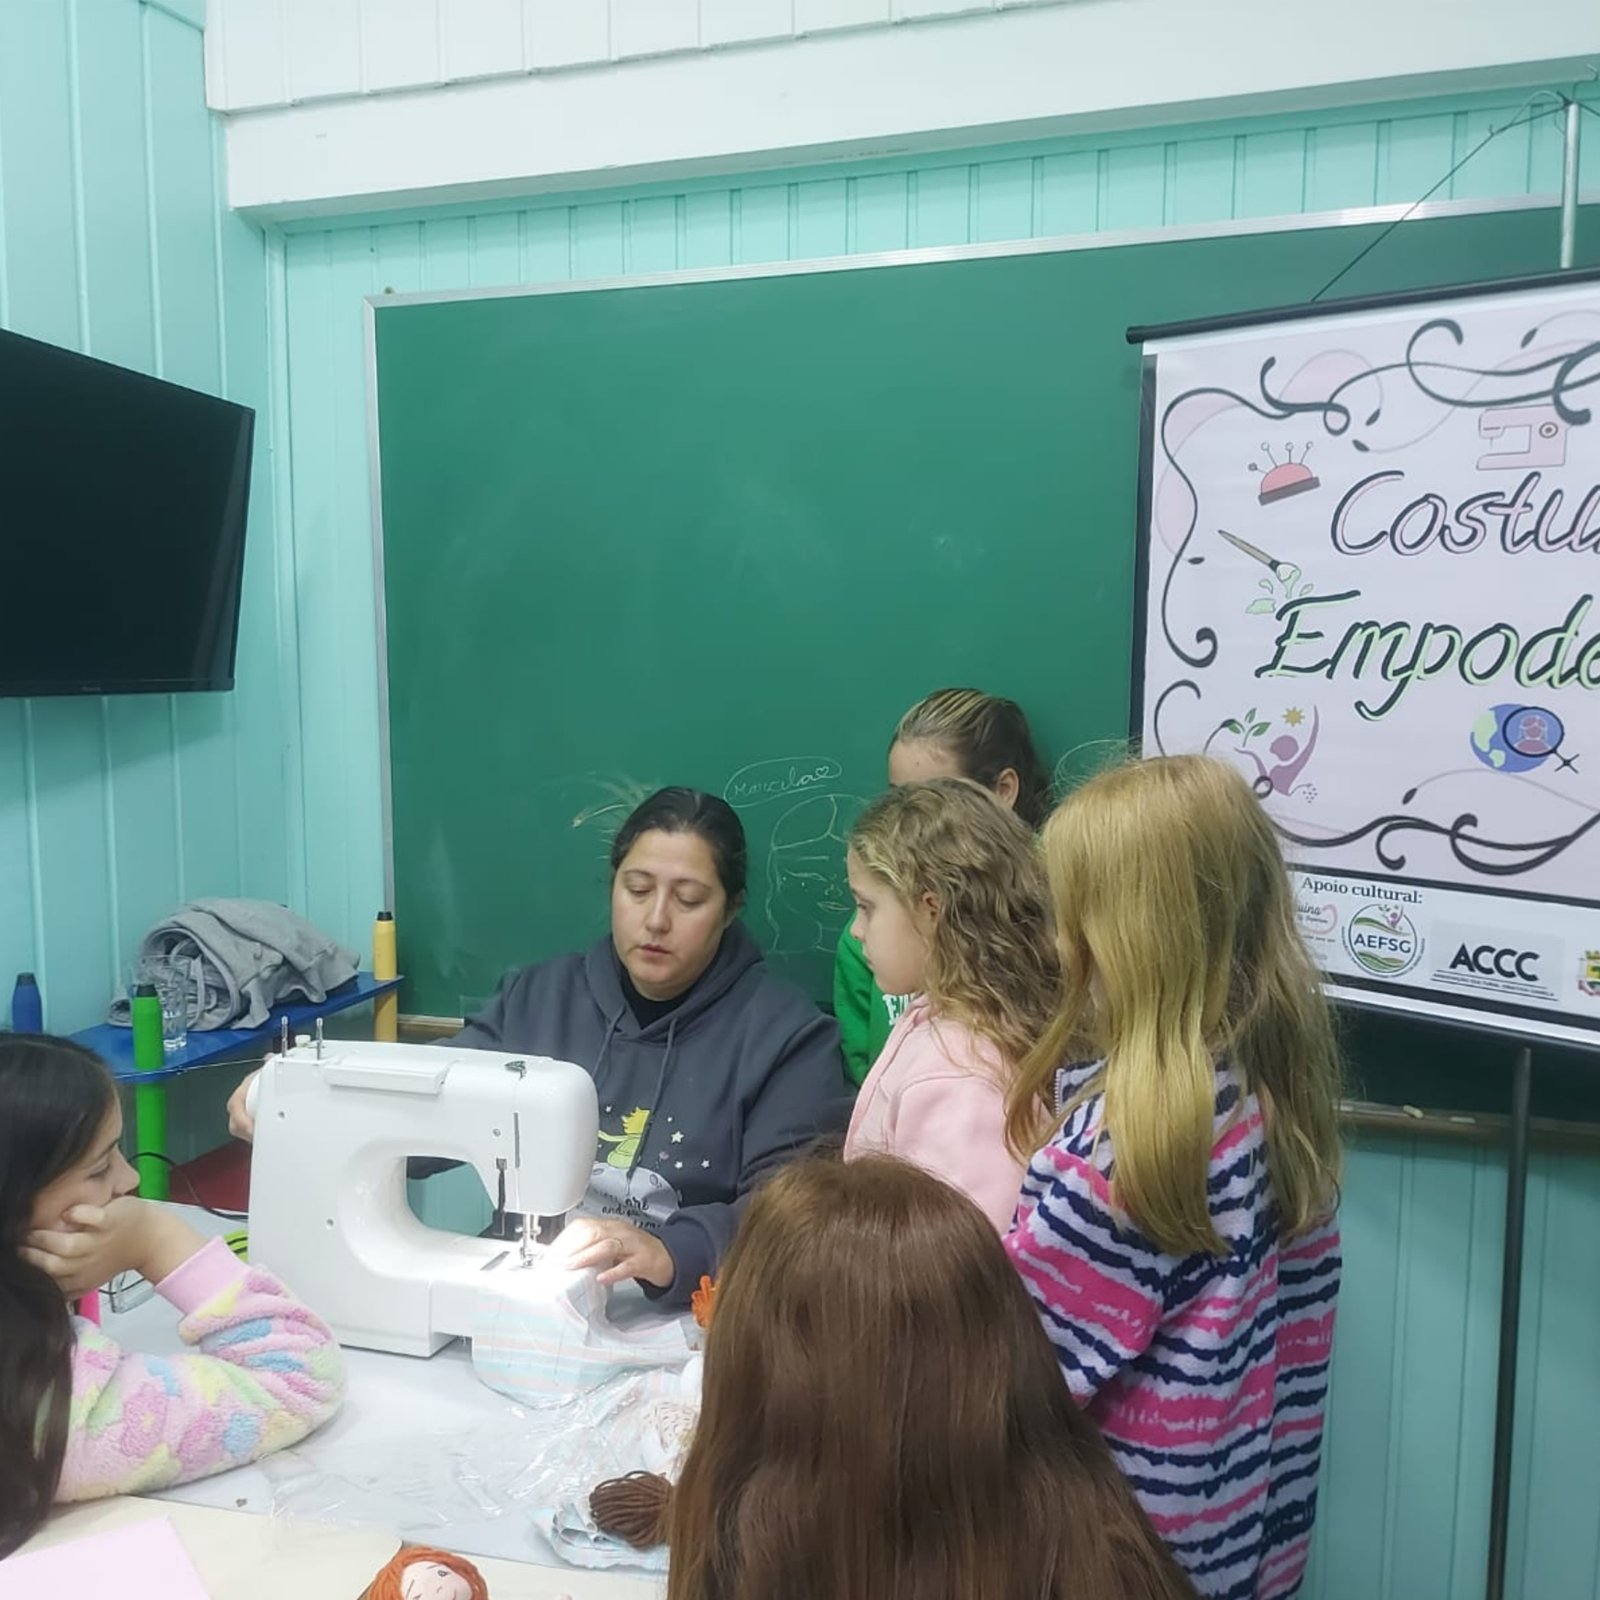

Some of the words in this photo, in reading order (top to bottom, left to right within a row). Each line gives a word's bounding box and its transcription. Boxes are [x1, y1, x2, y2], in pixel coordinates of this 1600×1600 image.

[1331, 471, 1600, 556] Costu
[1302, 877, 1348, 894] Apoio
[1352, 885, 1423, 904] cultural:
[1353, 933, 1412, 954] AEFSG
[1449, 942, 1541, 982] ACCC
